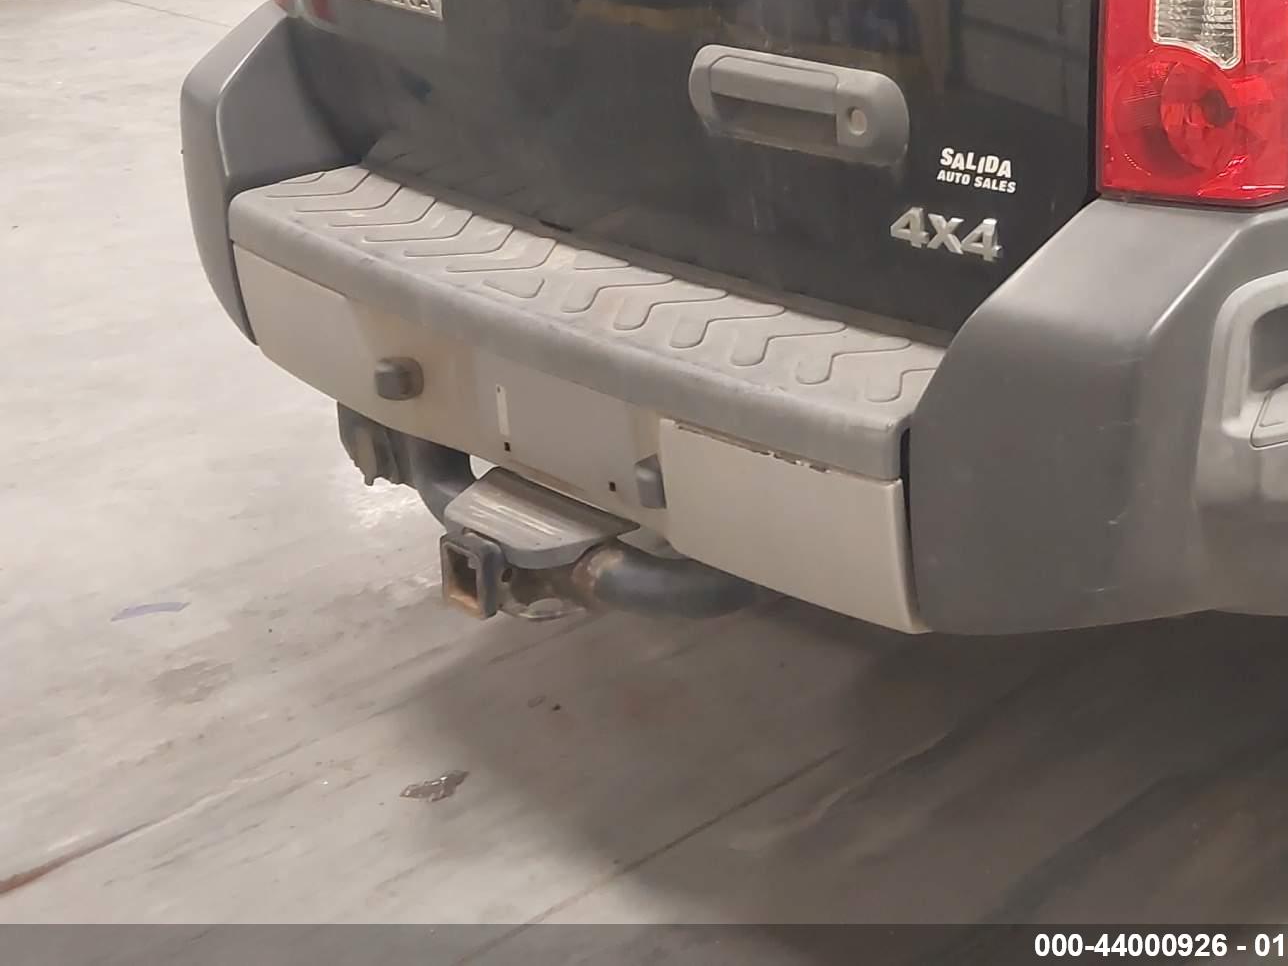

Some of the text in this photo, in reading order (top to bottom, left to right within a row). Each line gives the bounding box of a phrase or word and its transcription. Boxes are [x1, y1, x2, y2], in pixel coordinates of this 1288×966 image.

[940, 147, 1012, 179] SALIDA
[936, 169, 1017, 194] AUTO SALES
